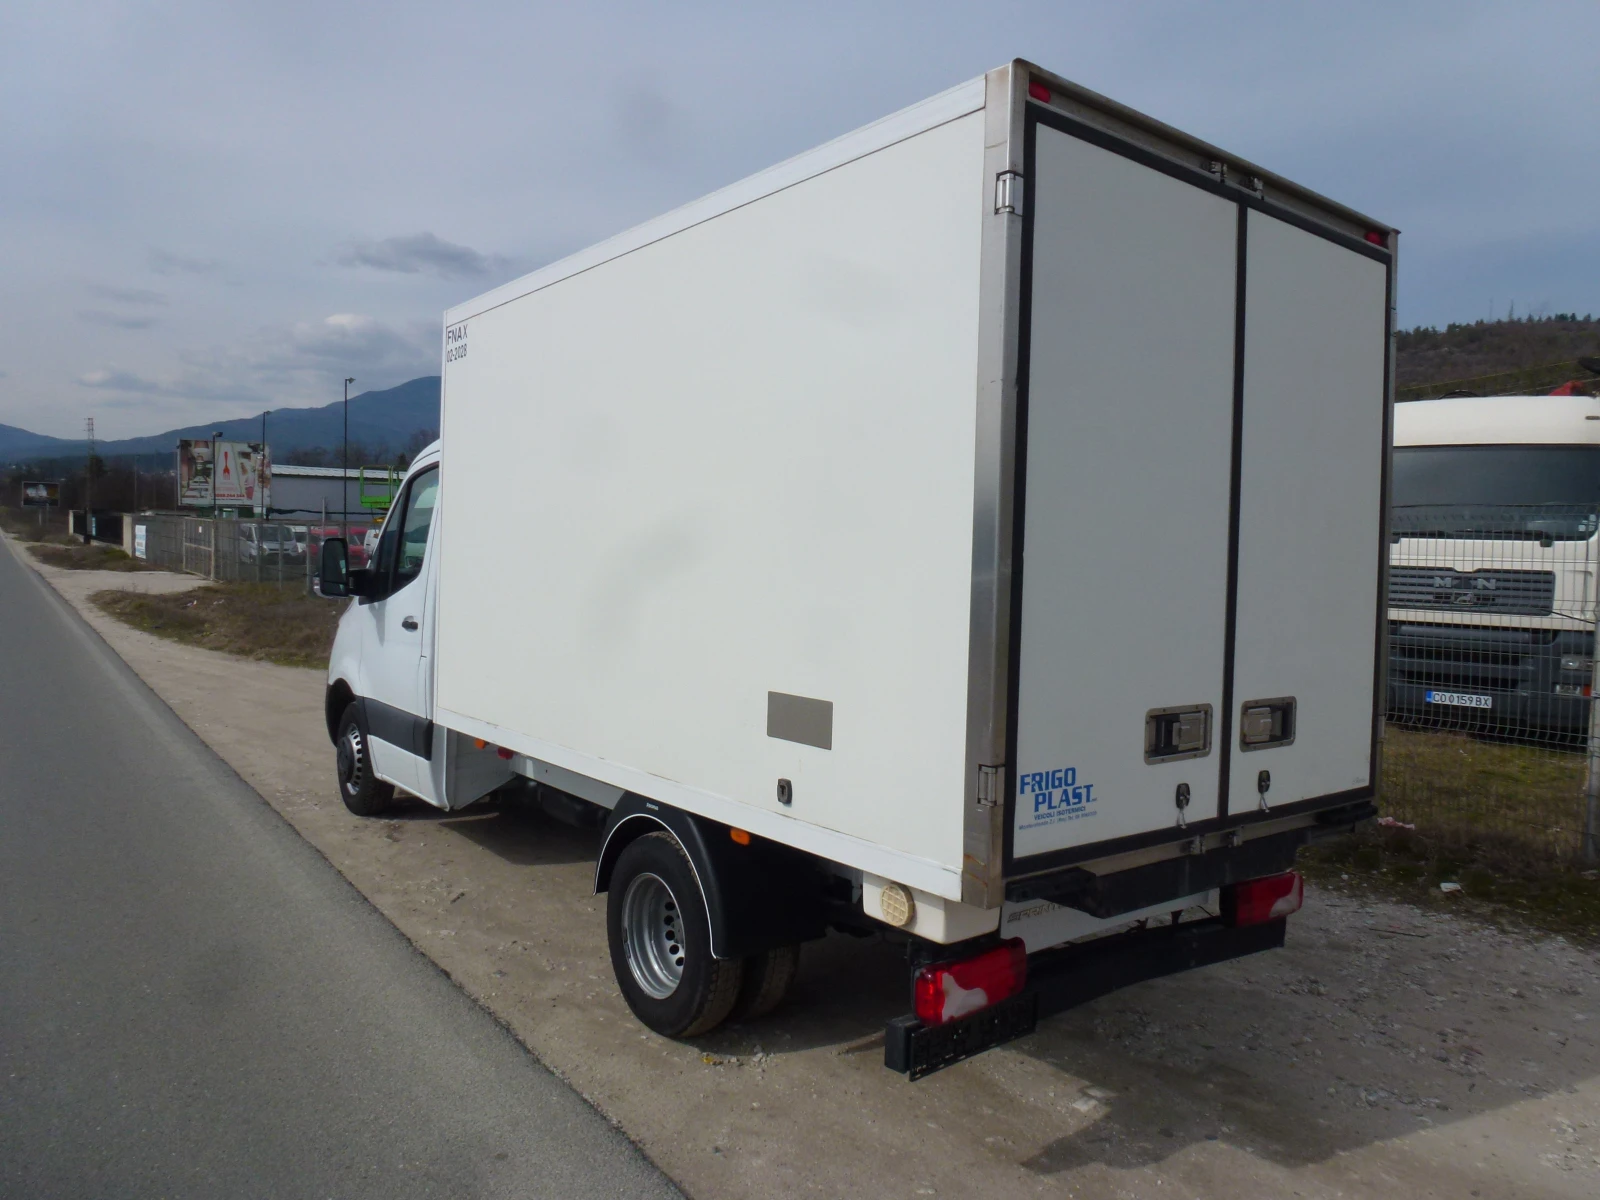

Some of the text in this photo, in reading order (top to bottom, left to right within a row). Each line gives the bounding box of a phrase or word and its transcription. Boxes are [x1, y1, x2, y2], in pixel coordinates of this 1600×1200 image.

[447, 323, 468, 345] FNAX
[1019, 766, 1076, 795] FRIGO
[1033, 784, 1094, 813] PLAST
[1033, 811, 1056, 821] VEICOLI
